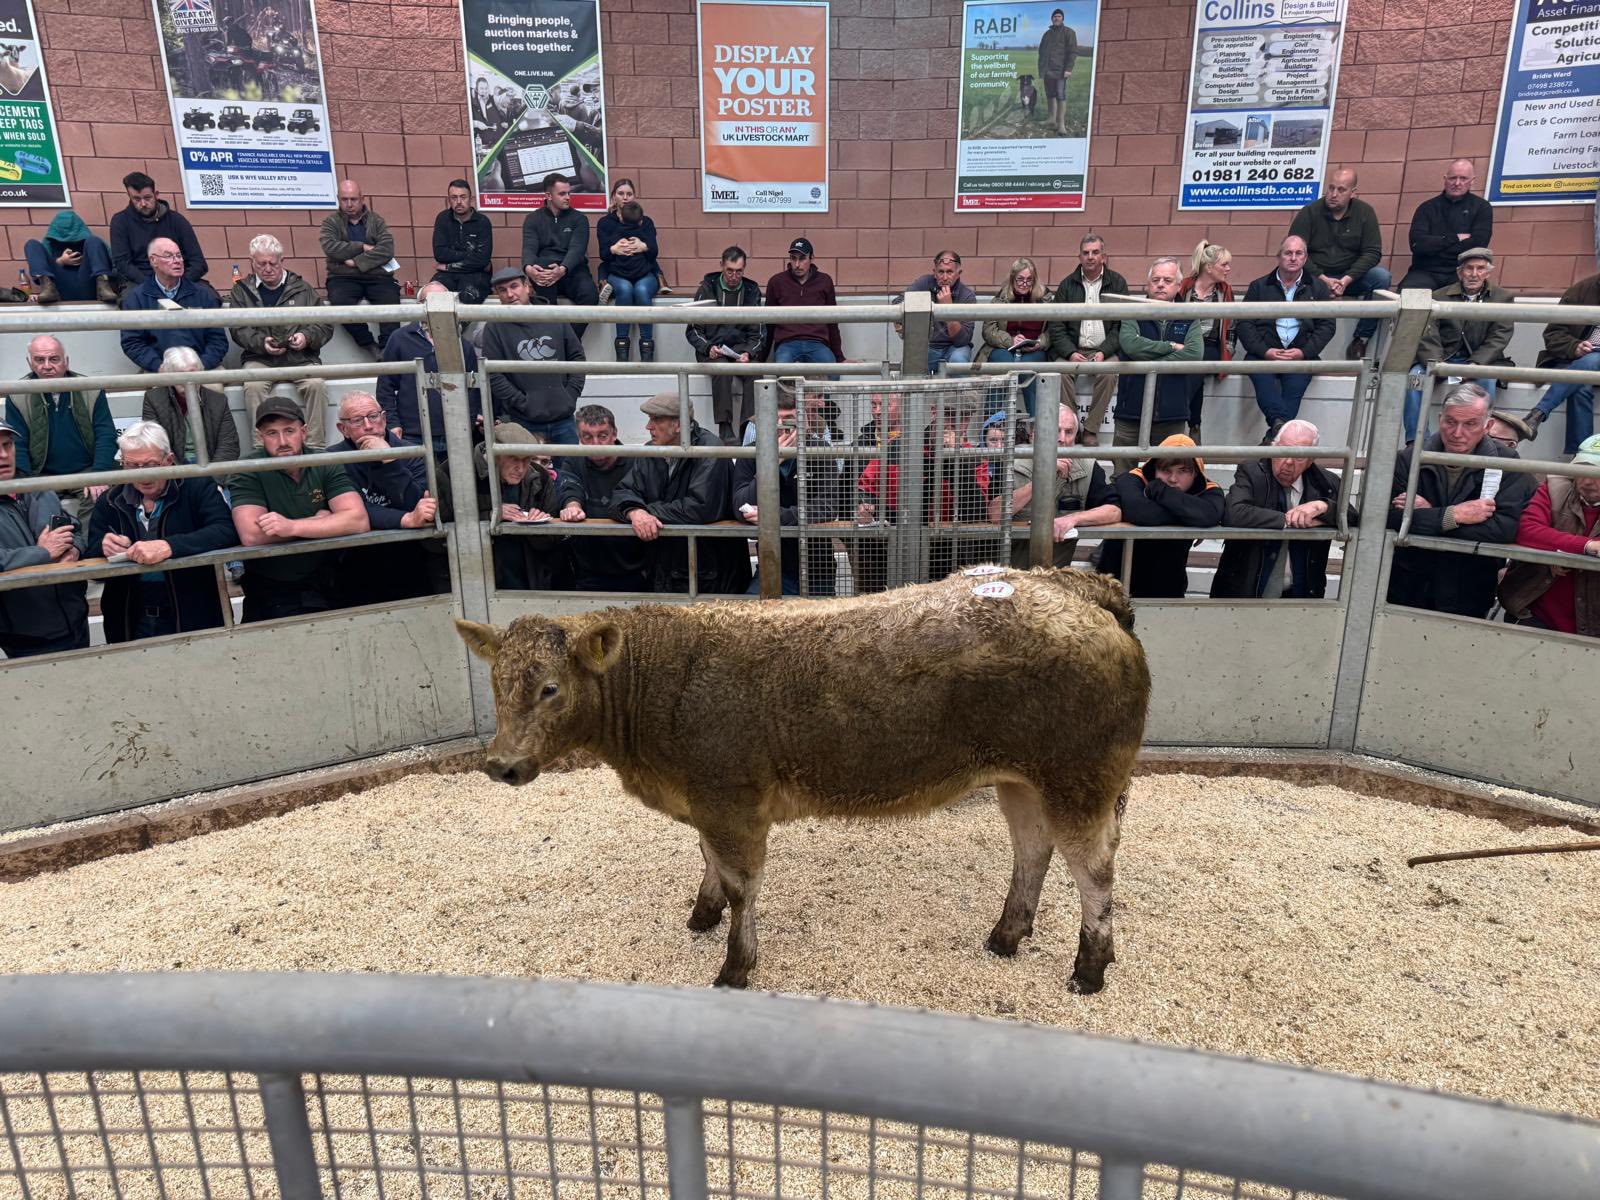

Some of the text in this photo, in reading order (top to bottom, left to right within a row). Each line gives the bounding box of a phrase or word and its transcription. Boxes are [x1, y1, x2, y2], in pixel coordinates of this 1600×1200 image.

[1204, 0, 1275, 21] Collins
[1537, 7, 1567, 18] Asset
[488, 14, 573, 27] Bringing people,
[974, 17, 1017, 34] RABI
[485, 28, 578, 39] auction markets &
[491, 41, 574, 53] prices together.
[714, 45, 815, 64] DISPLAY
[971, 53, 1009, 62] Supporting
[713, 67, 816, 95] YOUR
[718, 98, 812, 116] POSTER
[1525, 103, 1546, 112] New
[1548, 101, 1566, 110] and
[1570, 99, 1594, 108] Used
[20, 119, 44, 130] TAGS
[1517, 118, 1538, 126] Cars
[3, 132, 46, 141] WHEN SOLD
[1528, 146, 1585, 156] Refinancing
[190, 151, 233, 163] 0% APR
[1552, 161, 1598, 170] Livestock
[1192, 168, 1314, 182] 01981 240 682
[711, 191, 739, 200] IMEL
[1190, 185, 1313, 196] www.collinsdb.co.uk
